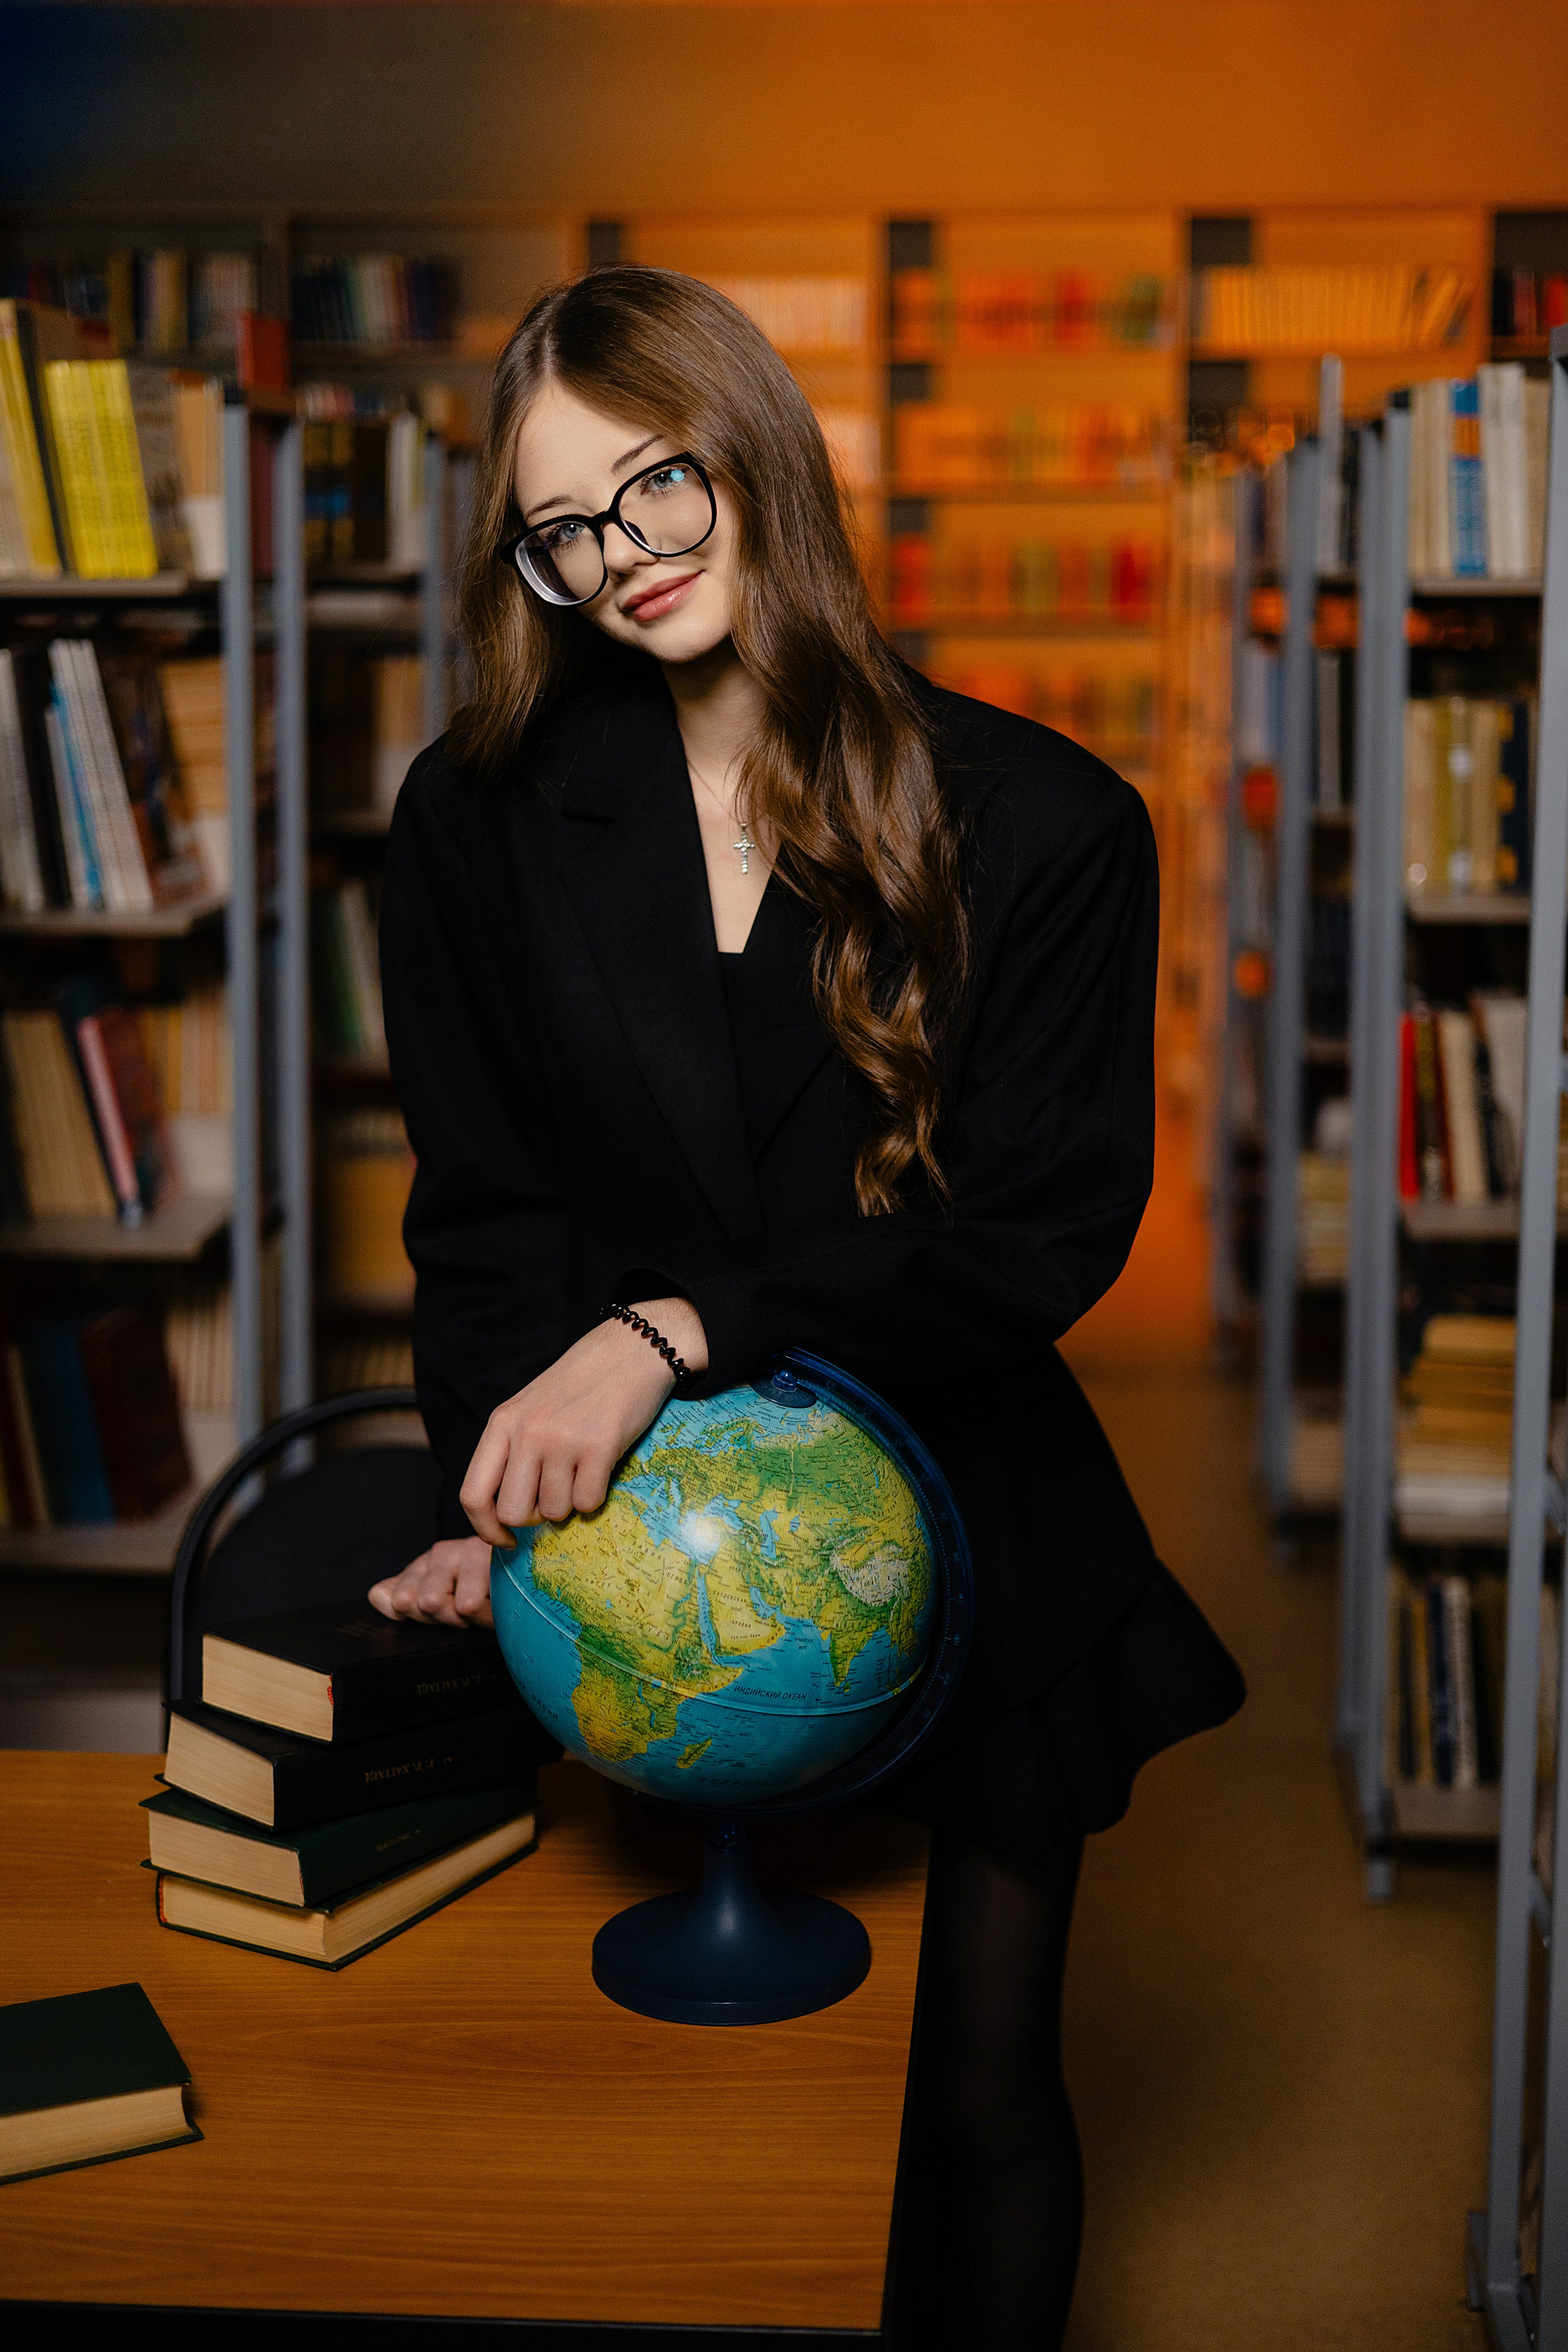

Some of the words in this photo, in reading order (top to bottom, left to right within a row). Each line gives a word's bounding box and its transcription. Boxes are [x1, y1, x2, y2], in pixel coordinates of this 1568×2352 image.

[725, 1512, 736, 1522] МОРЕ
[659, 1521, 682, 1542] СРЕДИЗЕМНОЕ
[632, 1541, 662, 1560] ЛИВИЯ
[584, 1578, 611, 1588] НИГЕР
[666, 1572, 692, 1586] ЕГИПЕТ
[618, 1599, 638, 1613] ЧАД
[767, 1627, 782, 1643] ОМАН
[701, 1673, 737, 1692] СОМАЛИ
[734, 1685, 781, 1700] ИНДИЙСКИЙ
[782, 1691, 807, 1701] ОКЕАН
